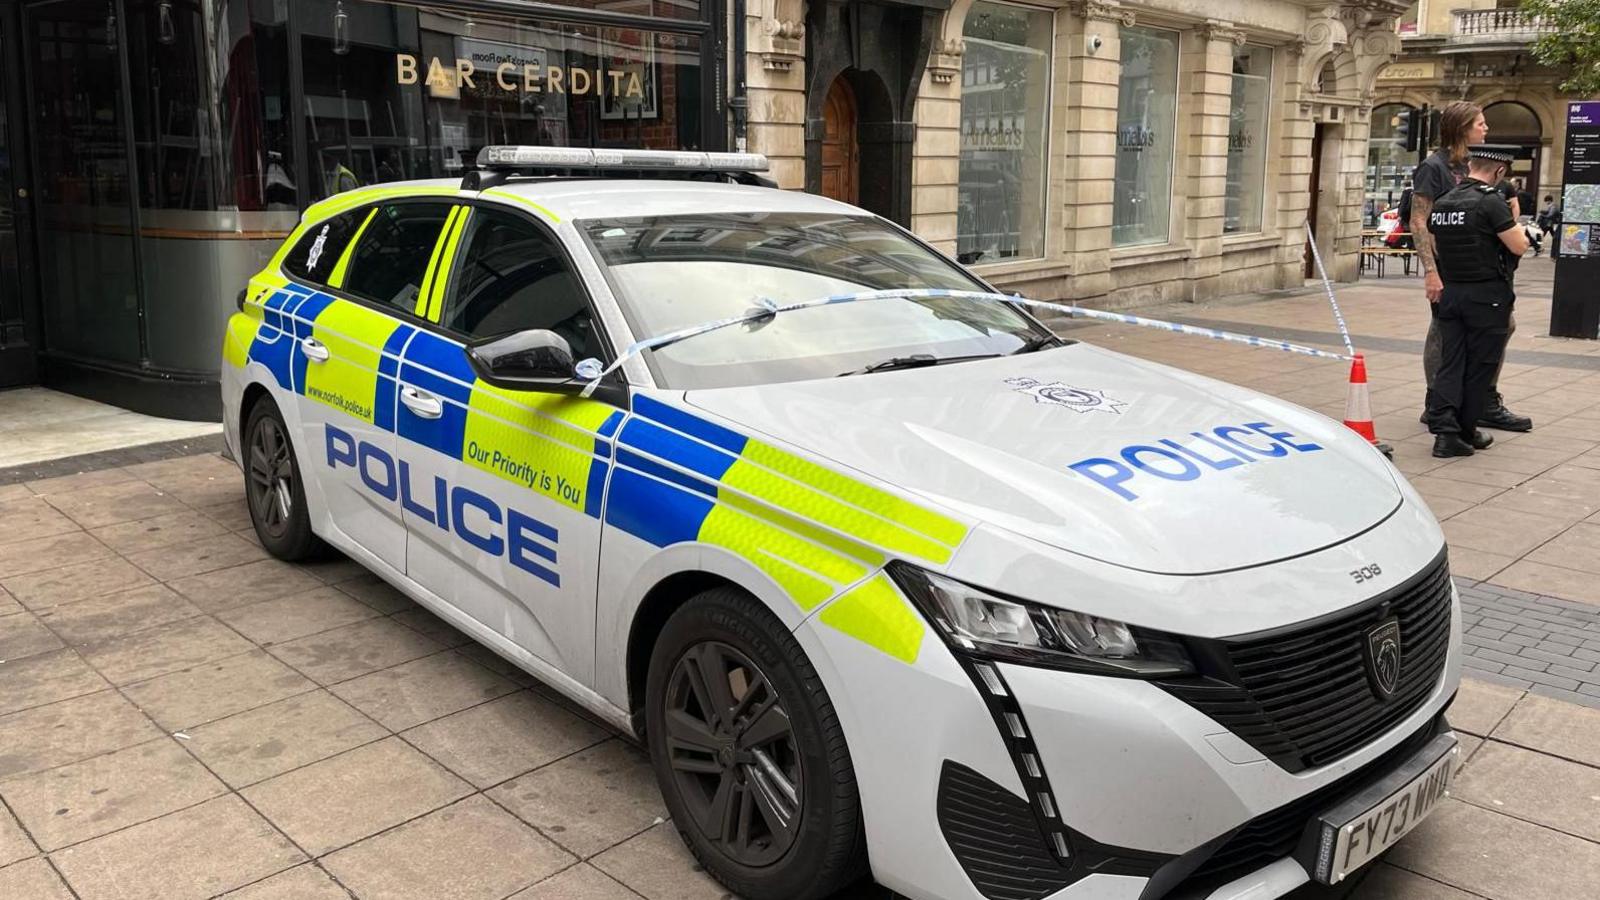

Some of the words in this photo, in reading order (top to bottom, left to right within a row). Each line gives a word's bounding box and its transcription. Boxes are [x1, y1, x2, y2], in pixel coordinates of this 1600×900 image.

[396, 53, 476, 89] BAR
[496, 61, 644, 98] CERDITA
[1431, 211, 1466, 226] POLICE
[308, 386, 371, 418] www.norfolk.police.uk
[468, 441, 490, 464] Our
[491, 450, 538, 489] Priority
[540, 470, 552, 491] is
[556, 474, 581, 504] You
[1066, 421, 1324, 502] POLICE
[325, 422, 561, 589] POLICE
[1349, 563, 1382, 584] 308
[1344, 792, 1411, 870] FY73
